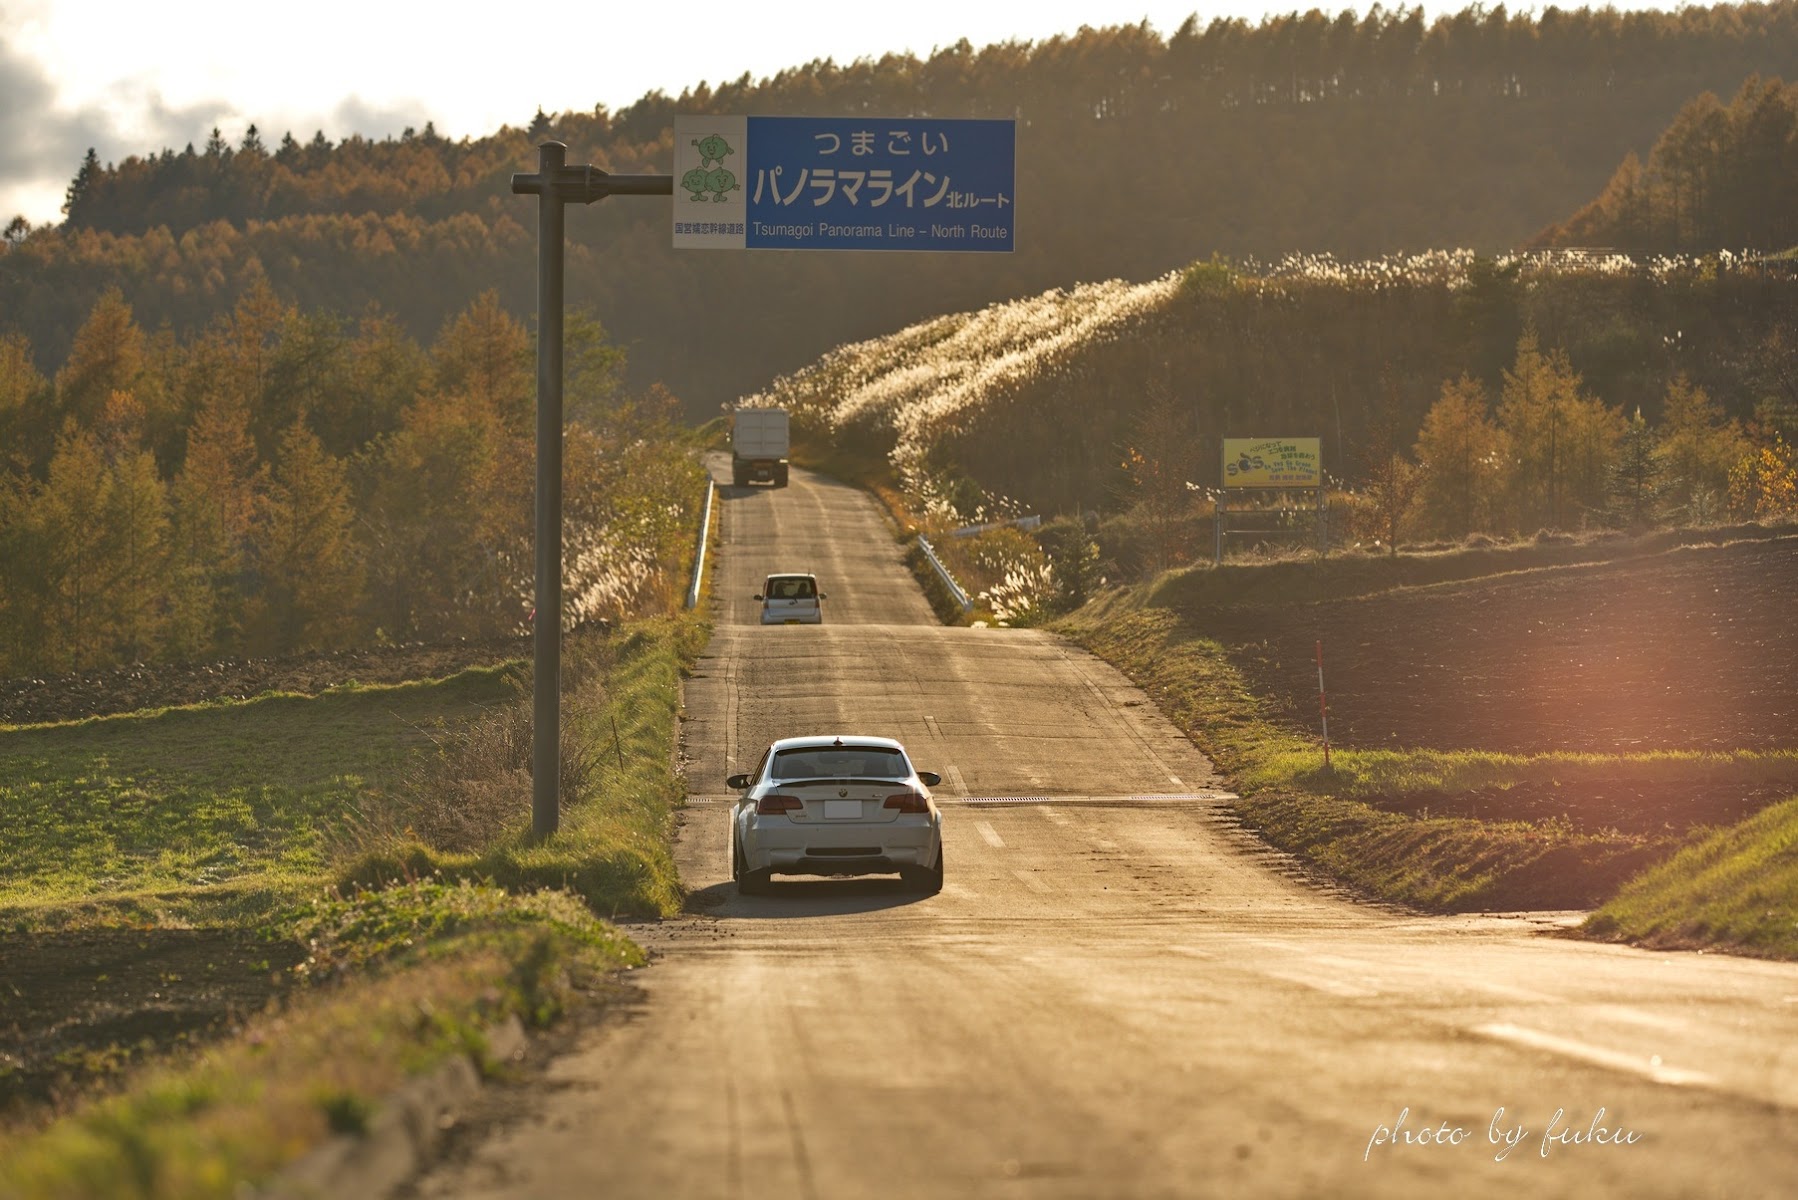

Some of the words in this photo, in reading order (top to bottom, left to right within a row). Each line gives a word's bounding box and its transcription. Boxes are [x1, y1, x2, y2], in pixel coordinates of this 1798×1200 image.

[814, 131, 949, 156] つまごい
[753, 165, 950, 208] パノラマライン
[946, 192, 1011, 209] 北ルート
[675, 222, 744, 235] 国営嬬恋幹線道路
[753, 222, 814, 240] Tsumagoi
[819, 222, 882, 237] Panorama
[888, 223, 915, 238] Line
[931, 224, 965, 238] North
[971, 225, 1008, 239] Route
